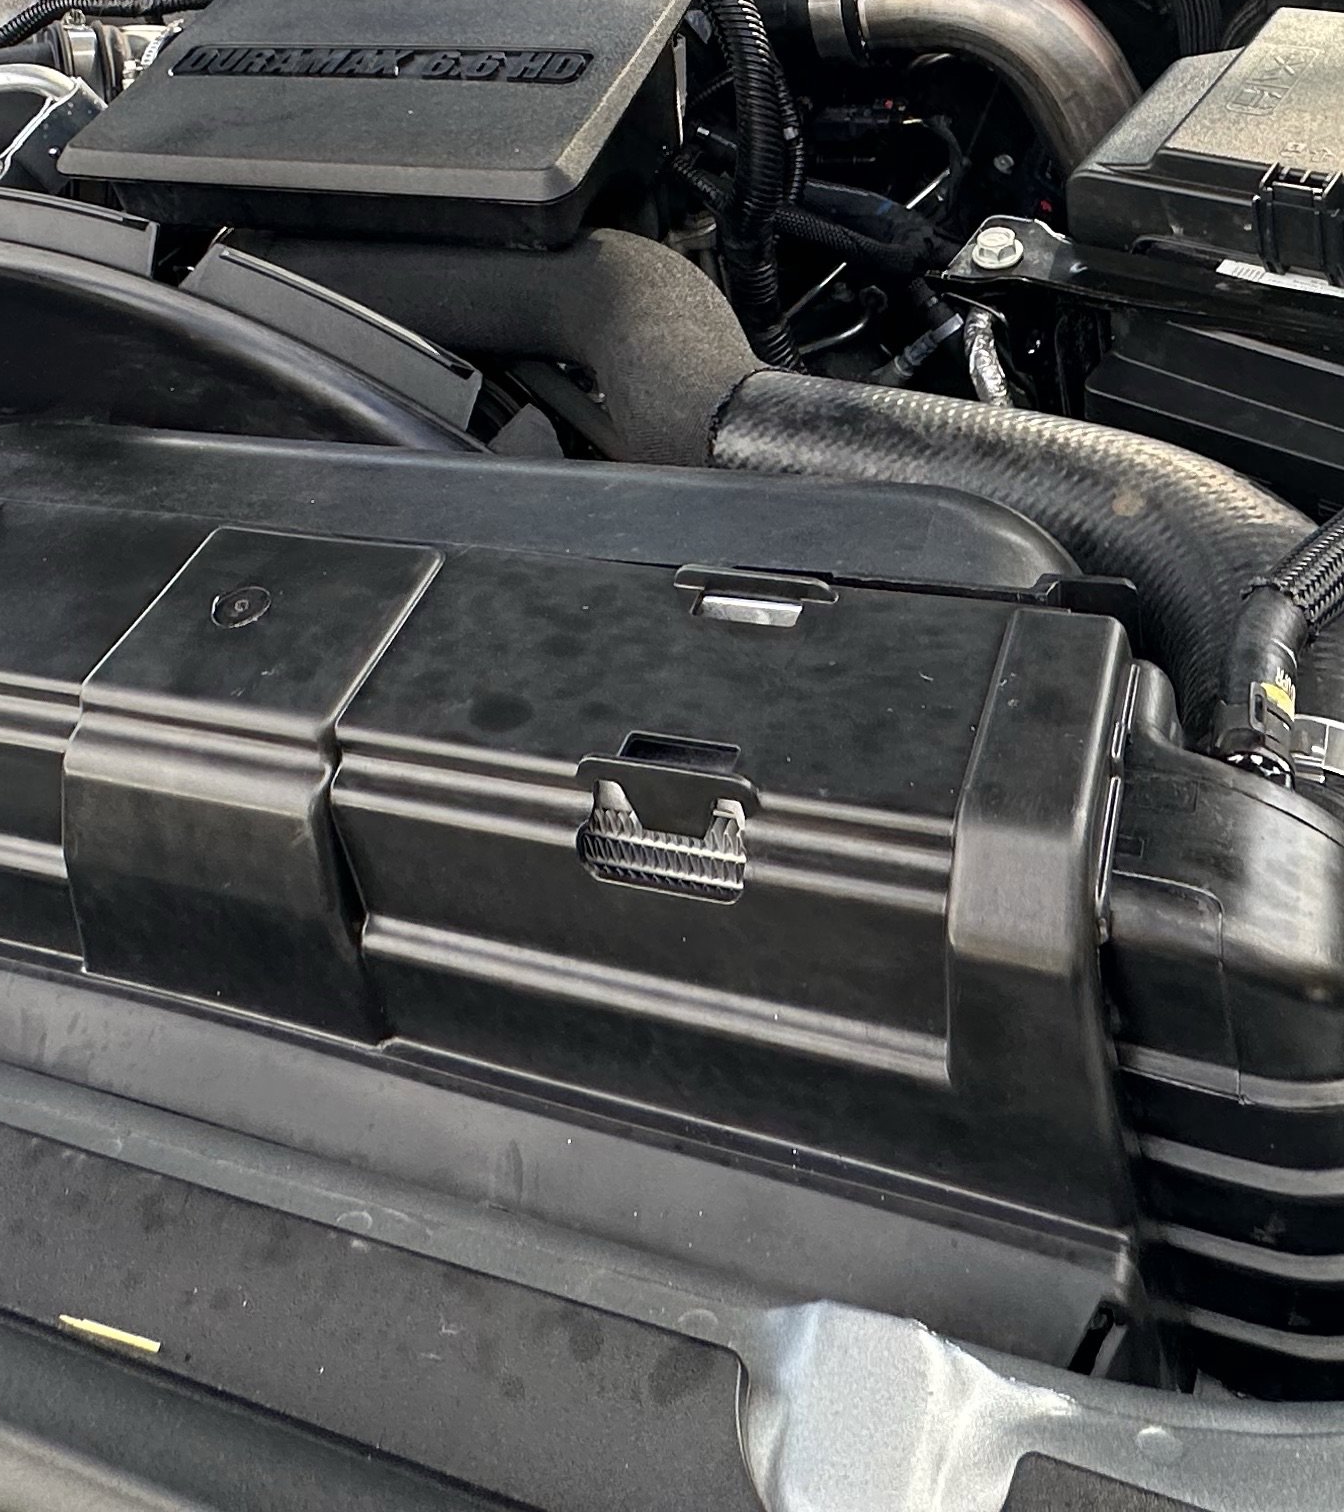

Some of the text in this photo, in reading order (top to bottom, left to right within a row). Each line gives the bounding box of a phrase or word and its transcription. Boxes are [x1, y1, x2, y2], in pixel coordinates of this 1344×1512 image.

[176, 47, 592, 82] DURAMAX 6.6 HD
